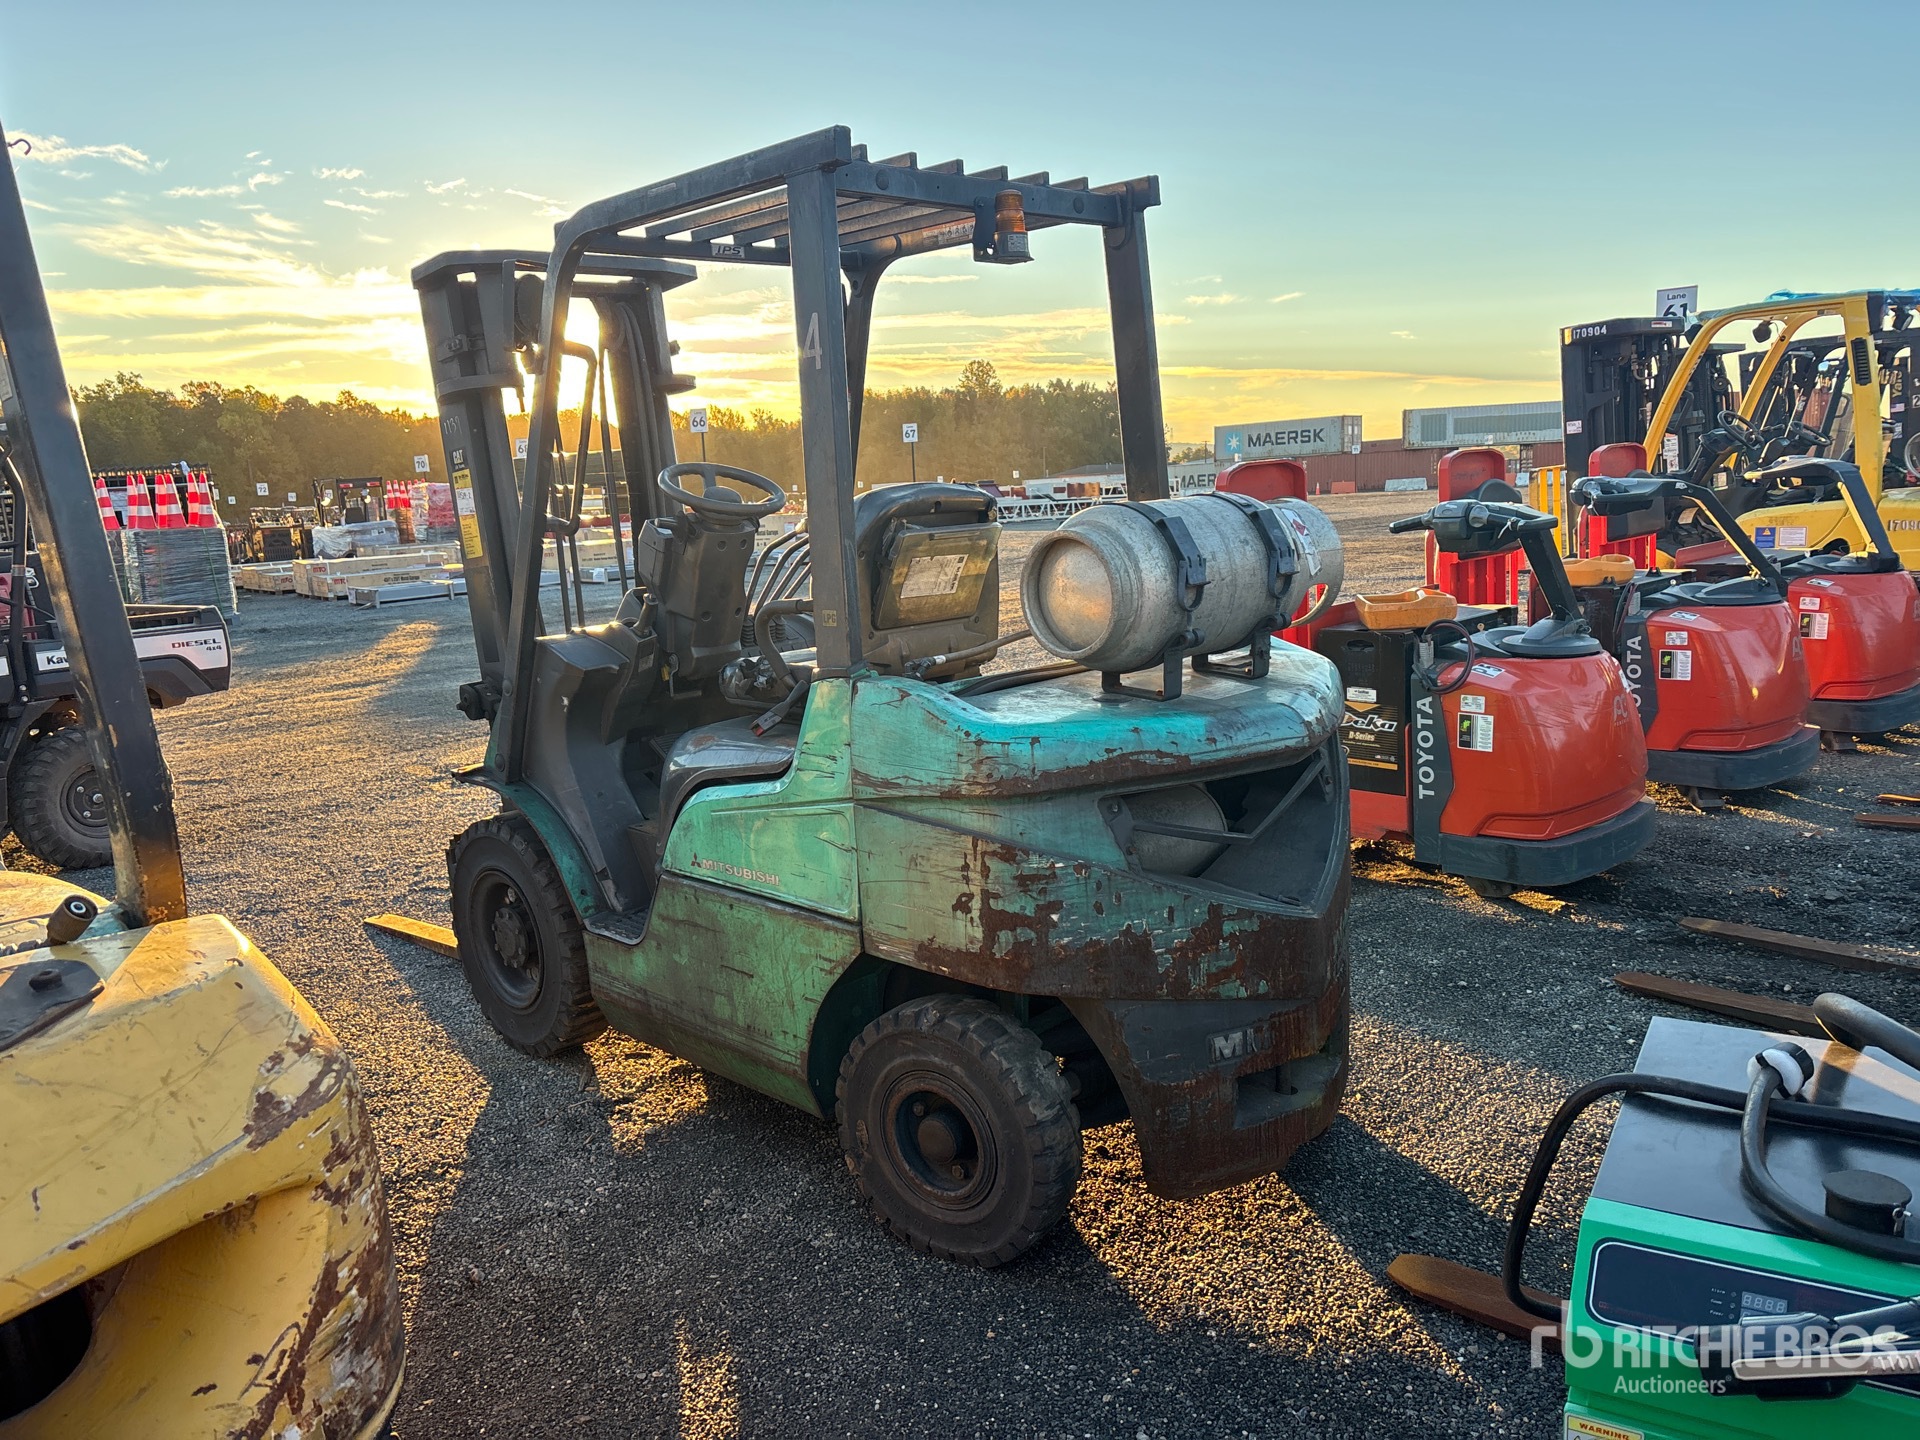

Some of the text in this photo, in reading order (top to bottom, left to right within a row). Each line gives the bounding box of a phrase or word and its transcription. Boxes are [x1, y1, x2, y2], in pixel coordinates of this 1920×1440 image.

[1666, 292, 1687, 301] Lane
[1573, 325, 1607, 340] 170904
[803, 312, 823, 370] 4
[692, 416, 706, 428] 66
[905, 429, 916, 439] 67
[1247, 427, 1325, 448] MAERSK
[415, 460, 426, 469] 70
[453, 450, 464, 464] CAT
[171, 638, 222, 649] DIESEL
[1626, 635, 1642, 718] OYOTA
[1341, 712, 1397, 732] Deka
[1348, 731, 1376, 742] D-Series
[1416, 695, 1435, 799] TOYOTA
[702, 859, 780, 886] MITSUBISHI
[1579, 1422, 1630, 1440] WARNING
